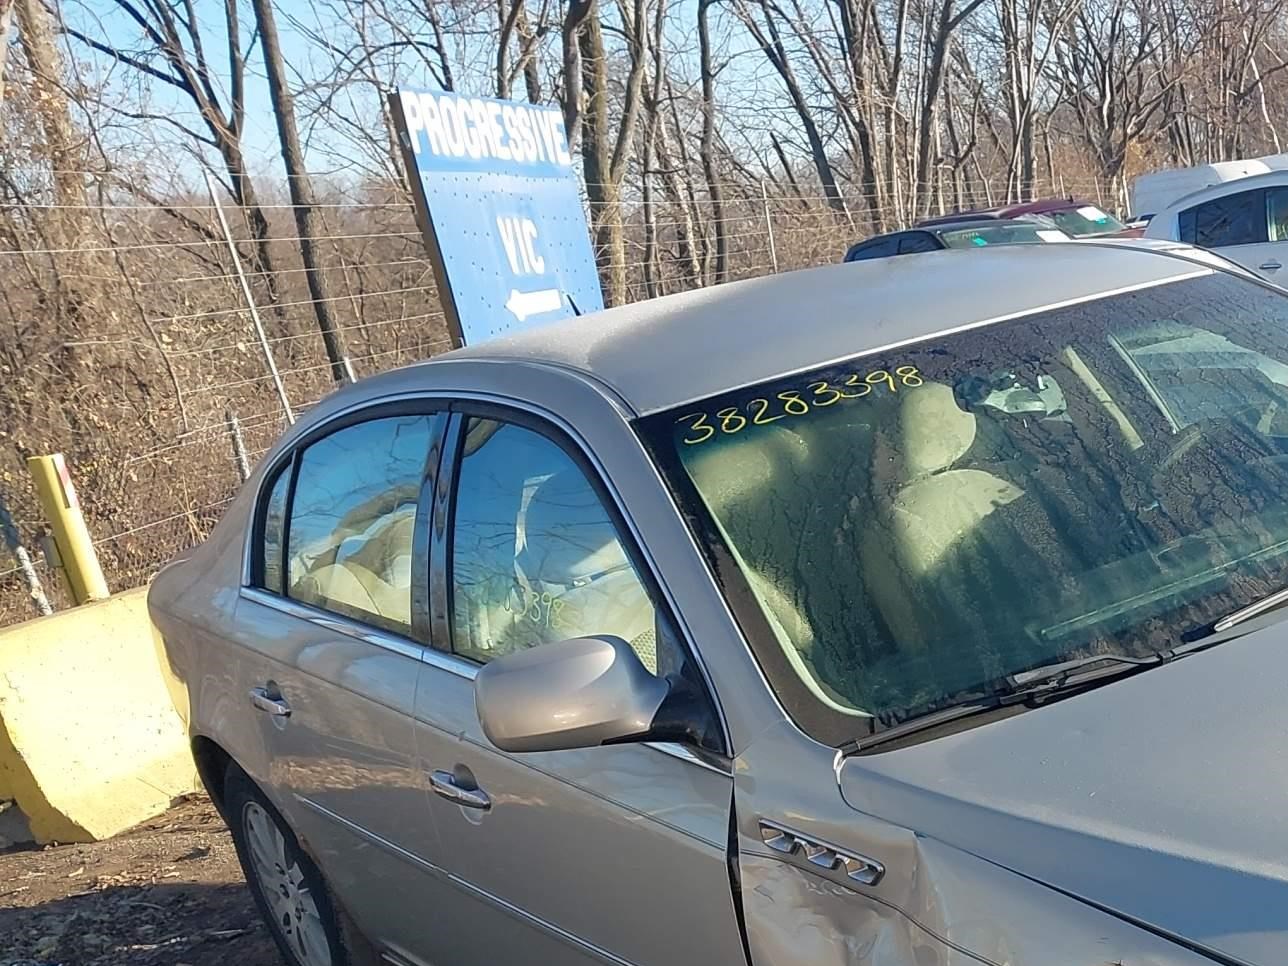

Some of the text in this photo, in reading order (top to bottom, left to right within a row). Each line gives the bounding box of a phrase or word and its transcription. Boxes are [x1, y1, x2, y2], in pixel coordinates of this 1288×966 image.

[400, 91, 571, 166] PROGRESSIVE
[496, 215, 545, 275] VIC
[675, 365, 924, 444] 38283398
